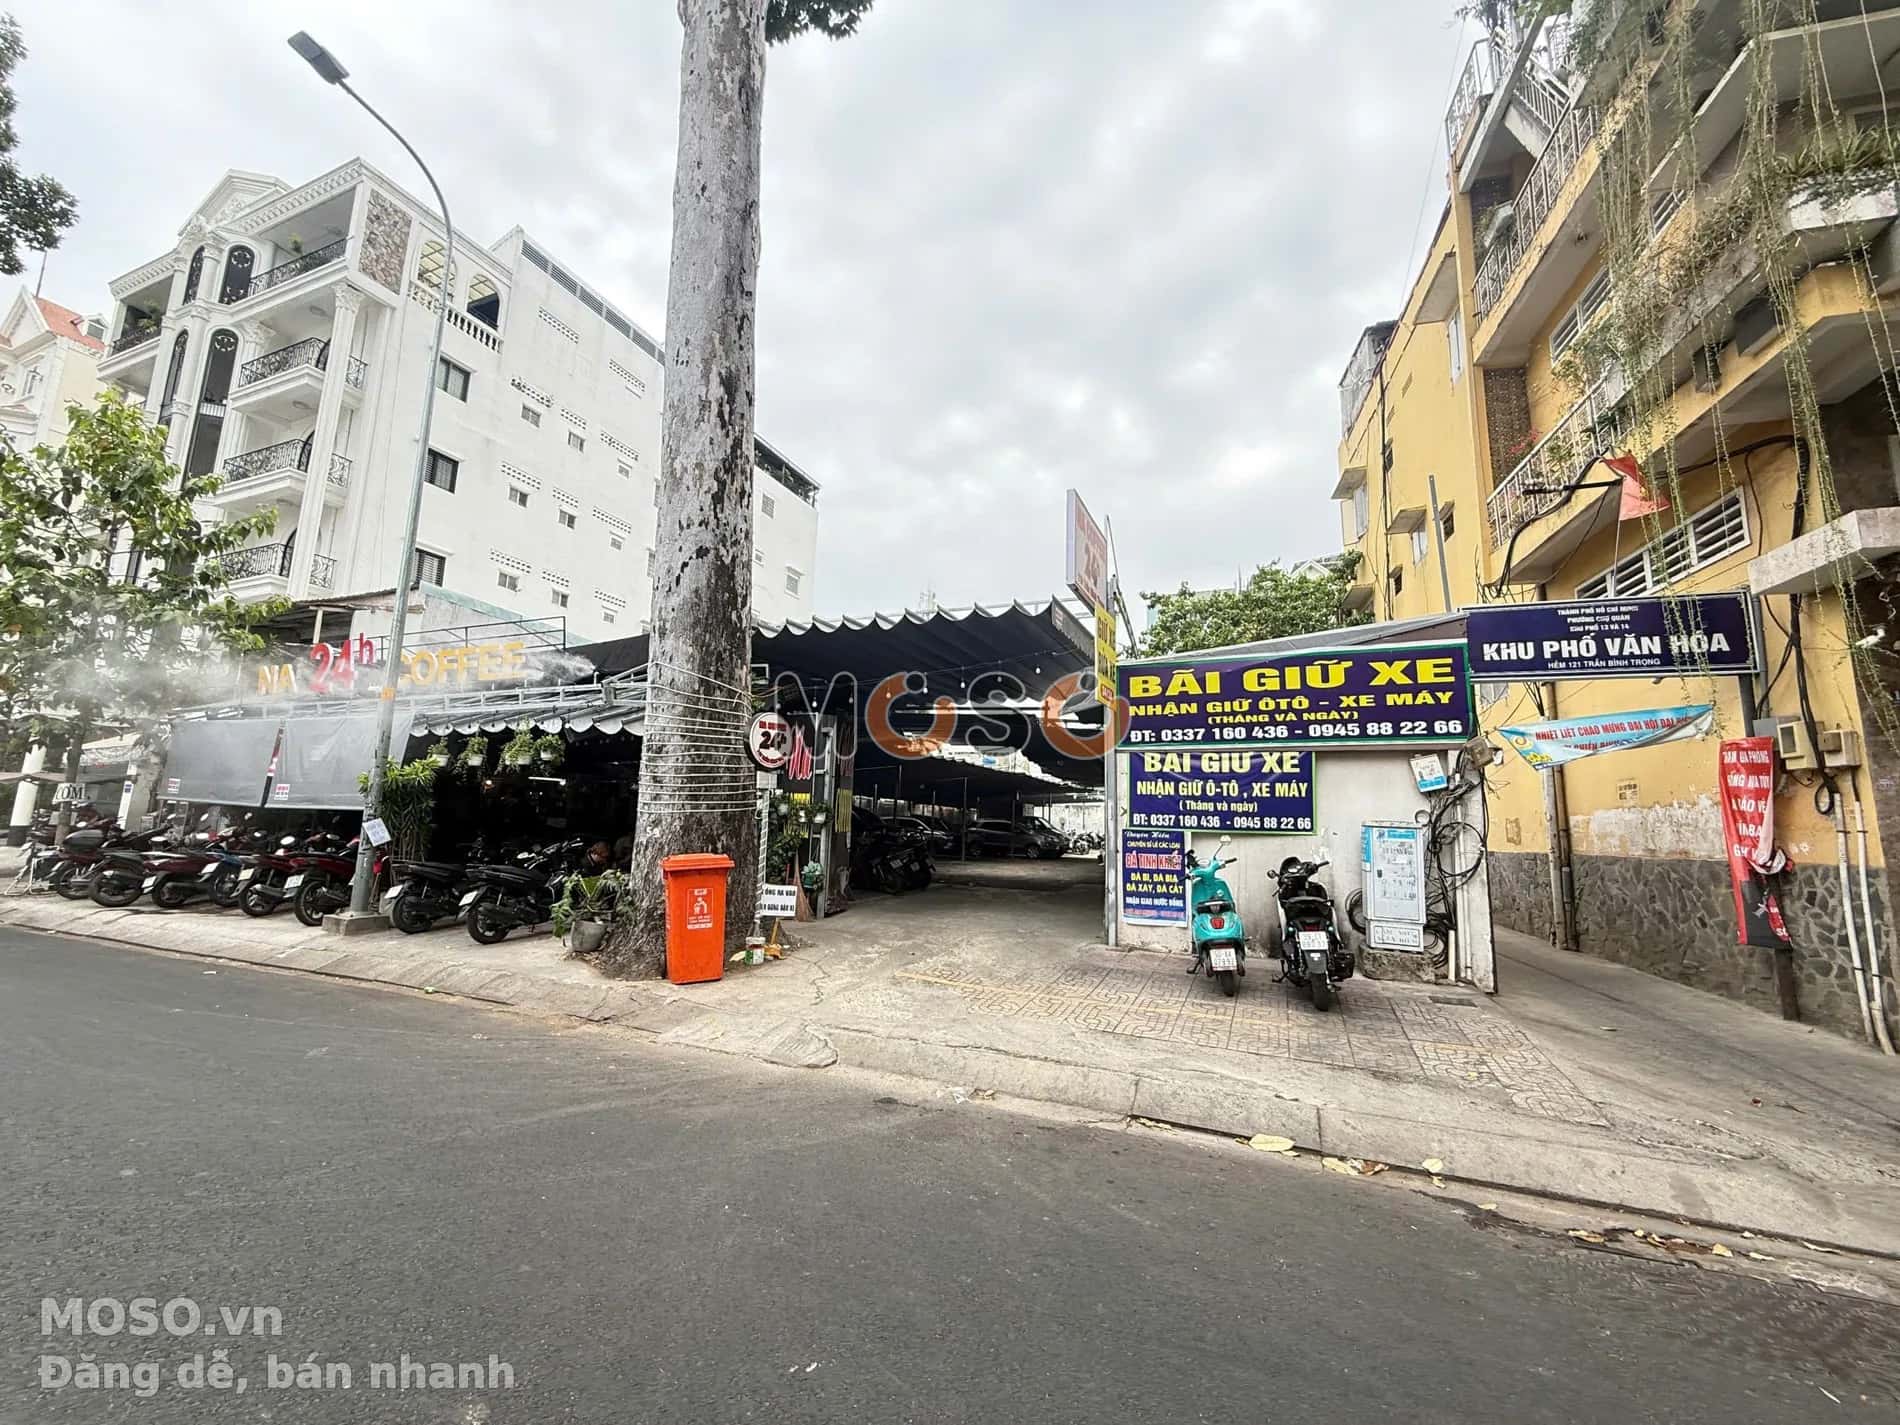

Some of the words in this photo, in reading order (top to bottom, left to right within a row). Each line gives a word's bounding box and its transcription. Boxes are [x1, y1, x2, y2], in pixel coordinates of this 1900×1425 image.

[1483, 640, 1535, 662] KHU
[1542, 632, 1598, 660] PHỐ
[1604, 633, 1662, 657] VĂN
[1669, 630, 1731, 653] HÓA
[1568, 661, 1581, 669] 121
[1583, 658, 1606, 668] TRẦN
[1607, 658, 1629, 667] BÌNH
[1630, 657, 1661, 666] TRỌNG
[256, 663, 298, 697] NA
[1129, 668, 1221, 699] BÃI
[1243, 659, 1353, 692] GIỮ
[1368, 657, 1456, 686] XE
[1129, 701, 1198, 718] NHẬN
[1206, 698, 1254, 714] GIỮ
[1258, 695, 1310, 711] ÔTÔ
[1339, 694, 1377, 708] XE
[1386, 690, 1454, 706] MÁY
[1207, 713, 1270, 725] (THÁNG
[1274, 711, 1298, 722] VÀ
[1302, 710, 1359, 722] NGÀY)
[1130, 729, 1157, 743] ĐT:
[1160, 728, 1206, 742] 0337
[1212, 726, 1248, 741] 160
[1251, 725, 1290, 740] 436
[1308, 723, 1361, 738] 0945
[1366, 722, 1394, 736] 88
[1399, 720, 1428, 735] 22
[1433, 719, 1463, 735] 66
[1261, 751, 1301, 774] XE
[1136, 778, 1175, 799] NHẬN
[1178, 778, 1204, 797] GIỮ
[1206, 779, 1239, 797] Ô-TÔ
[1251, 782, 1271, 797] XE
[1275, 779, 1308, 798] MÁY
[1216, 800, 1229, 811] và
[1230, 800, 1258, 813] ngày)
[1150, 813, 1176, 827] 0337
[1179, 814, 1198, 827] 160
[1200, 815, 1221, 828] 436
[1233, 816, 1261, 829] 0945
[1263, 817, 1278, 829] 88
[1280, 817, 1295, 829] 22
[1297, 817, 1312, 830] 66
[1125, 849, 1138, 869] ĐÁ
[1137, 853, 1158, 869] TINH
